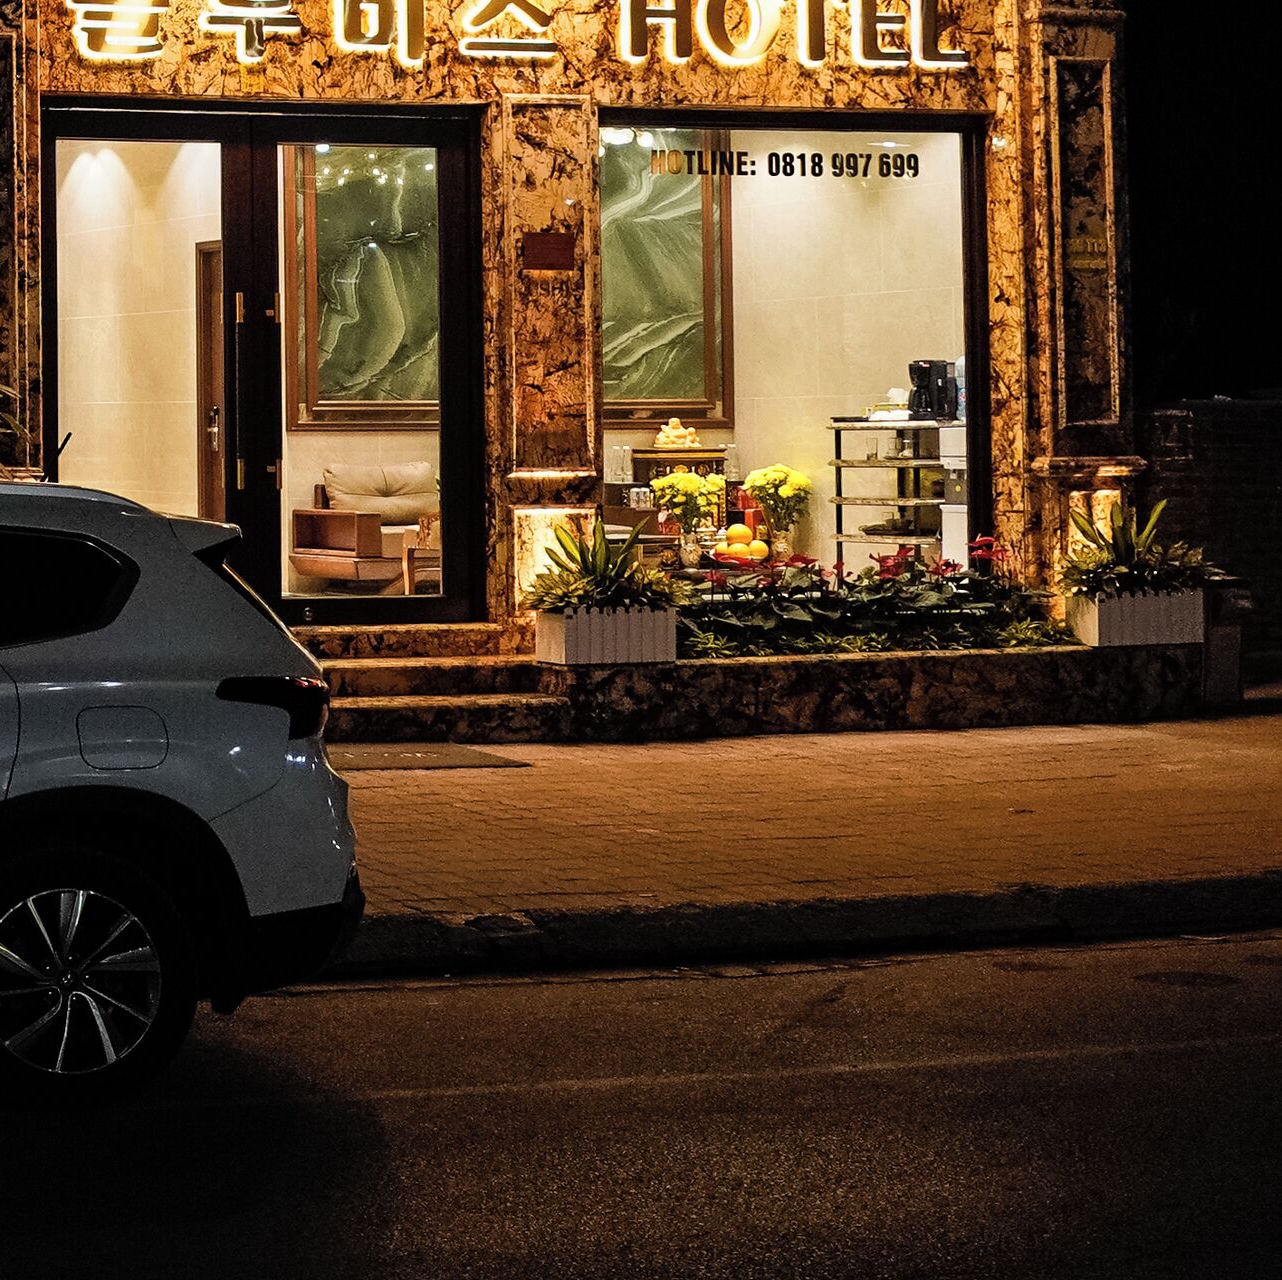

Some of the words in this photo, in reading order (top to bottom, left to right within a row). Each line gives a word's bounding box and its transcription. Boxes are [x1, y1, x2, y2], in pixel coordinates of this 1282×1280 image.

[649, 149, 757, 177] HOTLINE:
[767, 152, 824, 178] 0818
[831, 152, 873, 179] 997
[878, 152, 920, 179] 699
